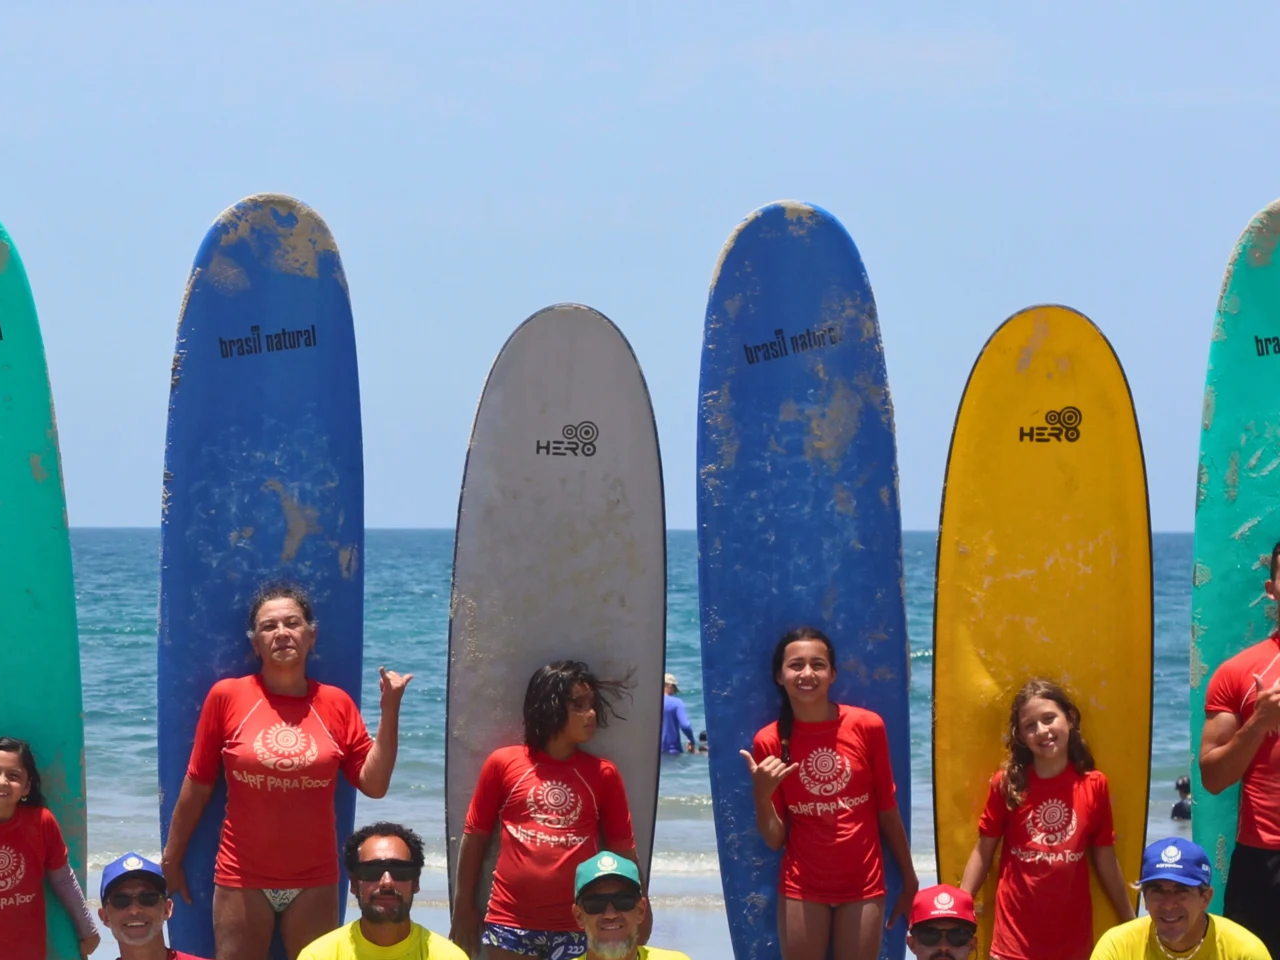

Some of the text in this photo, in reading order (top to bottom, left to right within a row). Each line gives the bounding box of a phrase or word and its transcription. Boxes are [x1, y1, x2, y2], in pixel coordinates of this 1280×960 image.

[219, 324, 317, 359] brasil natural
[744, 328, 789, 366] brasil
[1019, 425, 1081, 443] HERO
[535, 438, 598, 457] HERO
[232, 770, 265, 789] SURF
[266, 776, 299, 792] PARA
[788, 801, 815, 817] SURF
[816, 802, 844, 817] PARA
[506, 825, 536, 843] SURF
[536, 832, 567, 848] PARA
[1036, 851, 1065, 865] PARA
